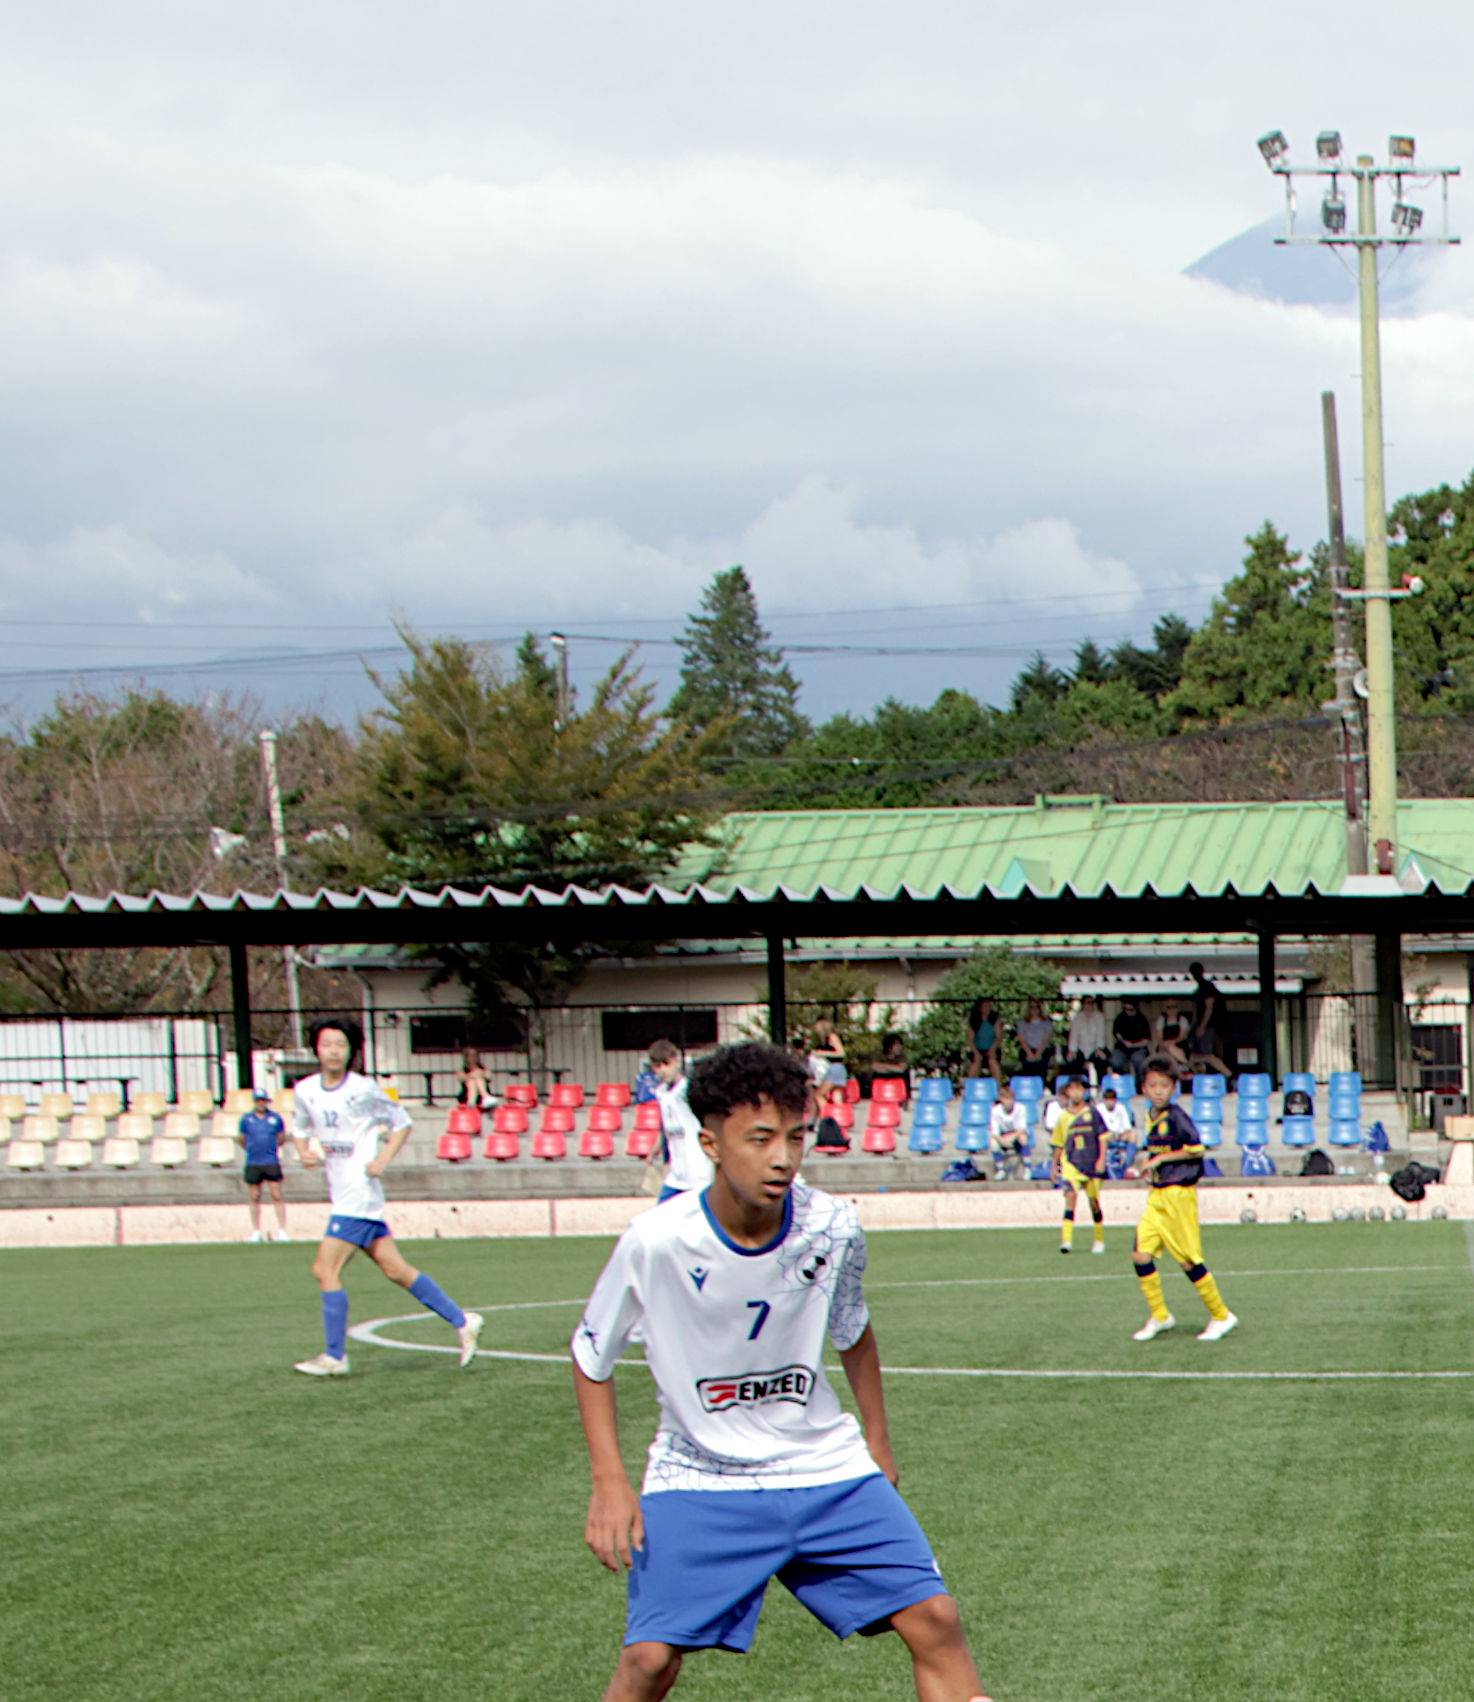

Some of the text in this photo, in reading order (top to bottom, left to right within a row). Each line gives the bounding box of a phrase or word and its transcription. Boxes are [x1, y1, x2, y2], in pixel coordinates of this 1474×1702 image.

[322, 1109, 339, 1128] 12
[746, 1301, 771, 1340] 7
[738, 1373, 807, 1402] ENZED
